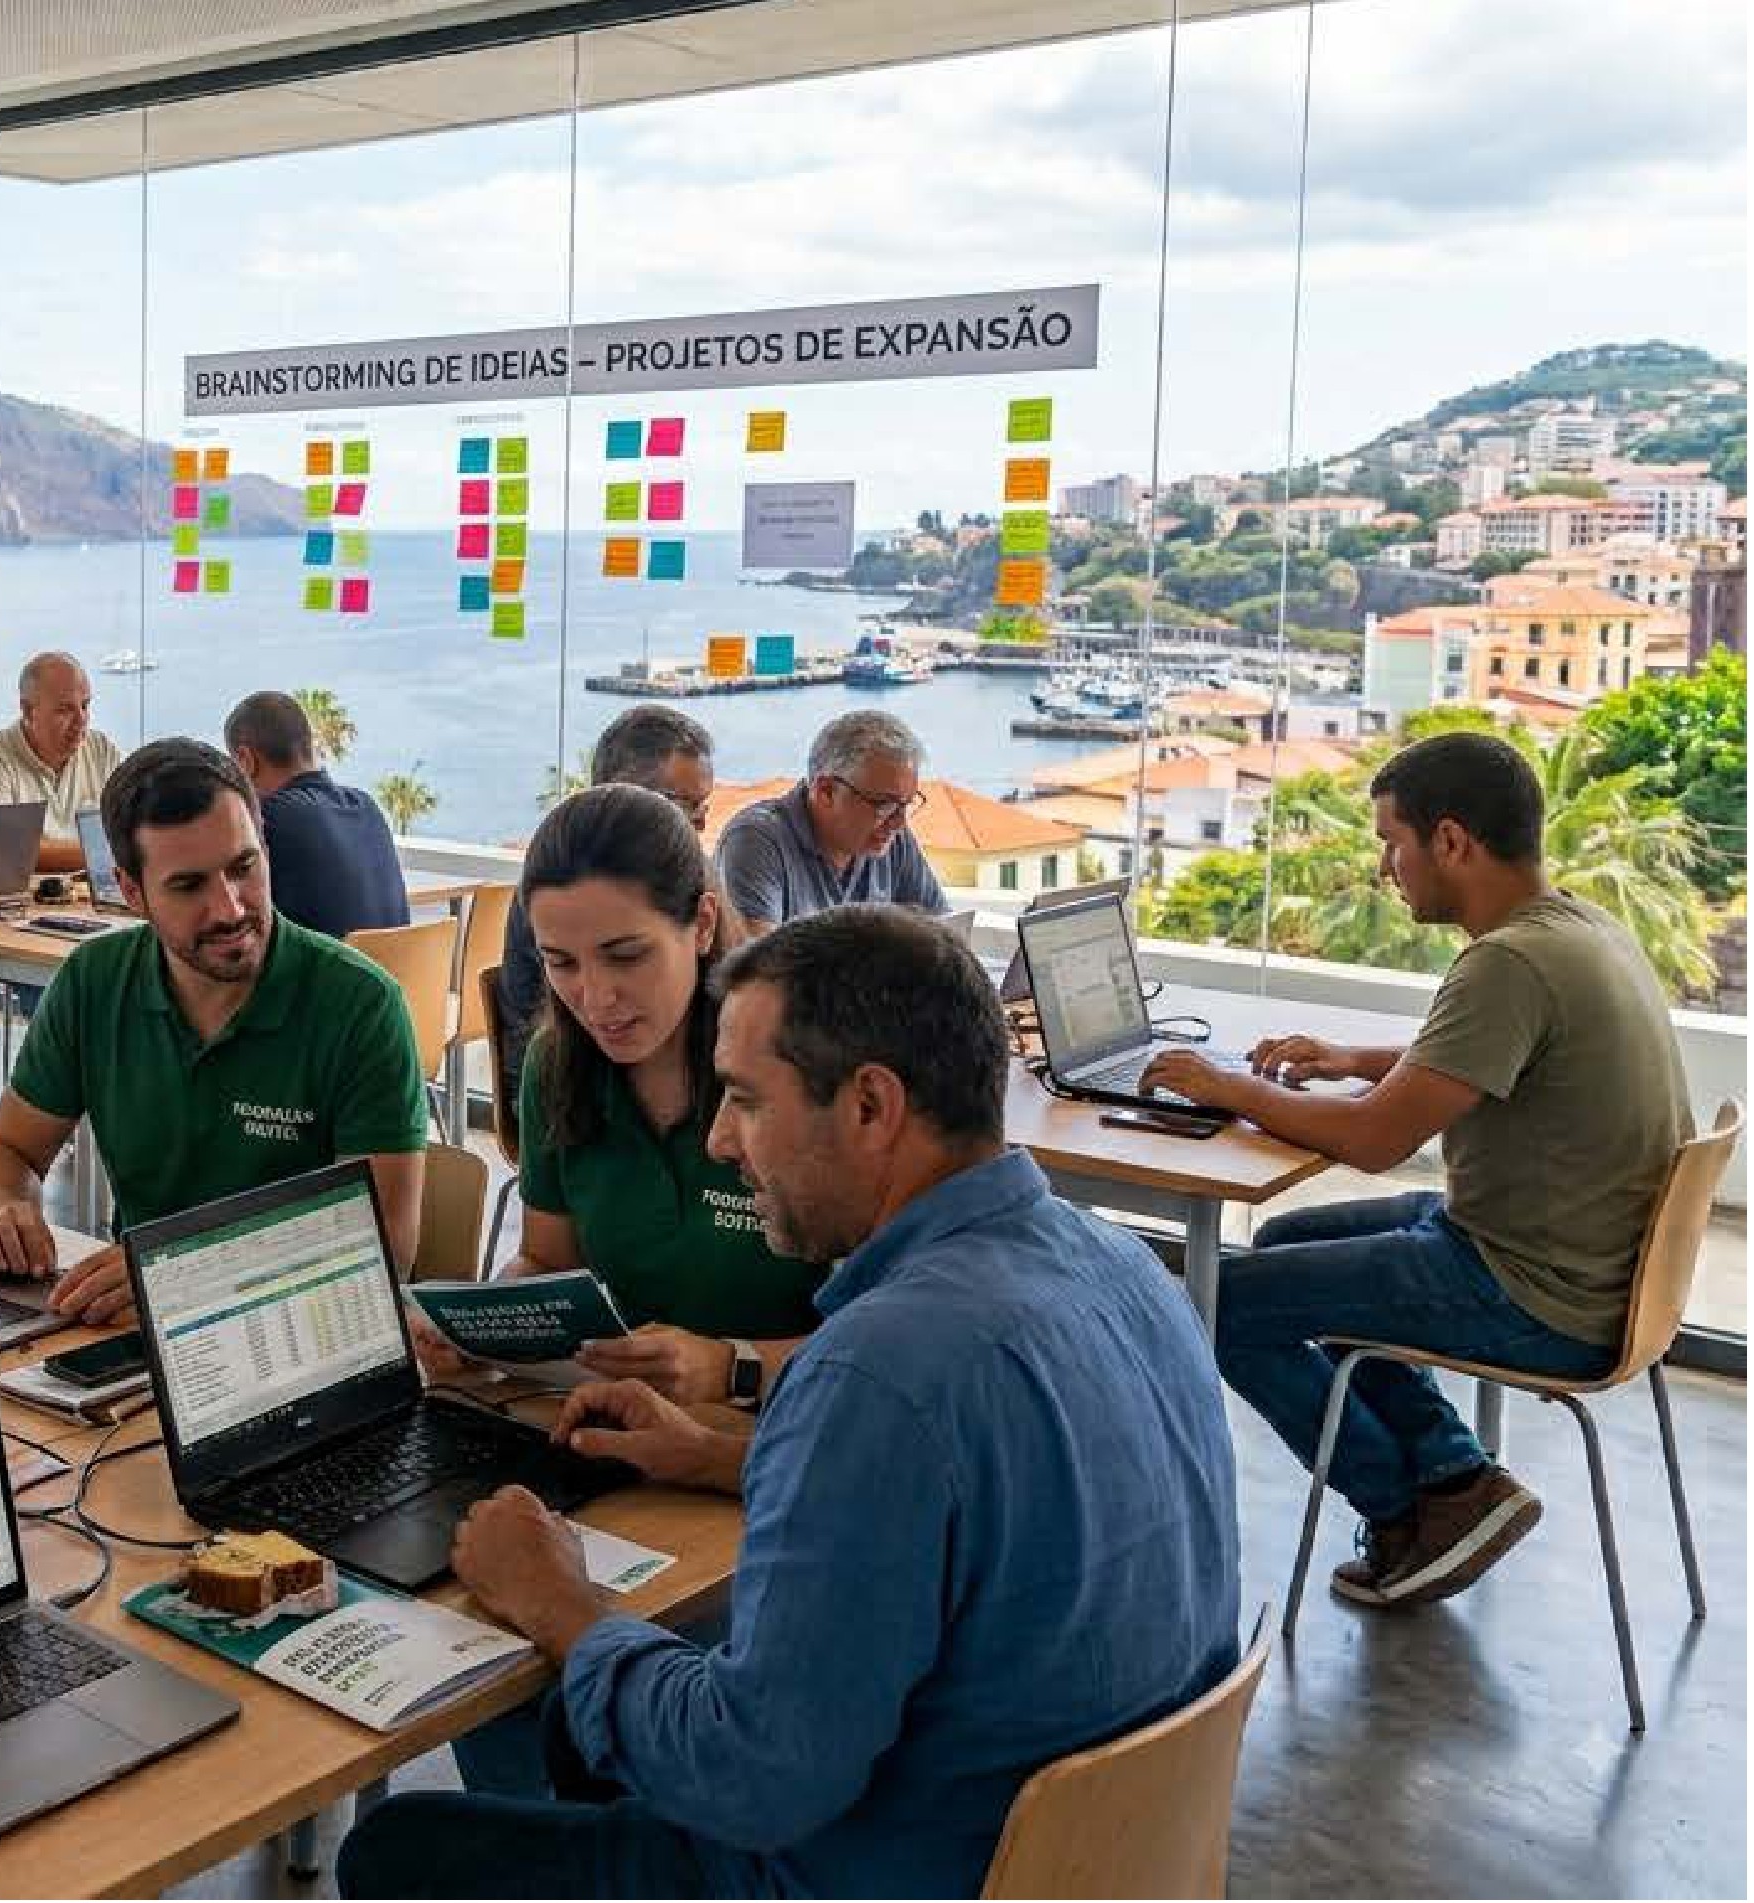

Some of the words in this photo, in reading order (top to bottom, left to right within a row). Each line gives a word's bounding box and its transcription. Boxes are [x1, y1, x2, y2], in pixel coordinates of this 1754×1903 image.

[196, 359, 416, 399] BRAINSTORMING
[425, 354, 462, 384] DE
[471, 348, 568, 382] IDEIAS
[606, 332, 784, 372] PROJETOS
[796, 328, 843, 362] DE
[854, 306, 1072, 360] EXPANSÃO
